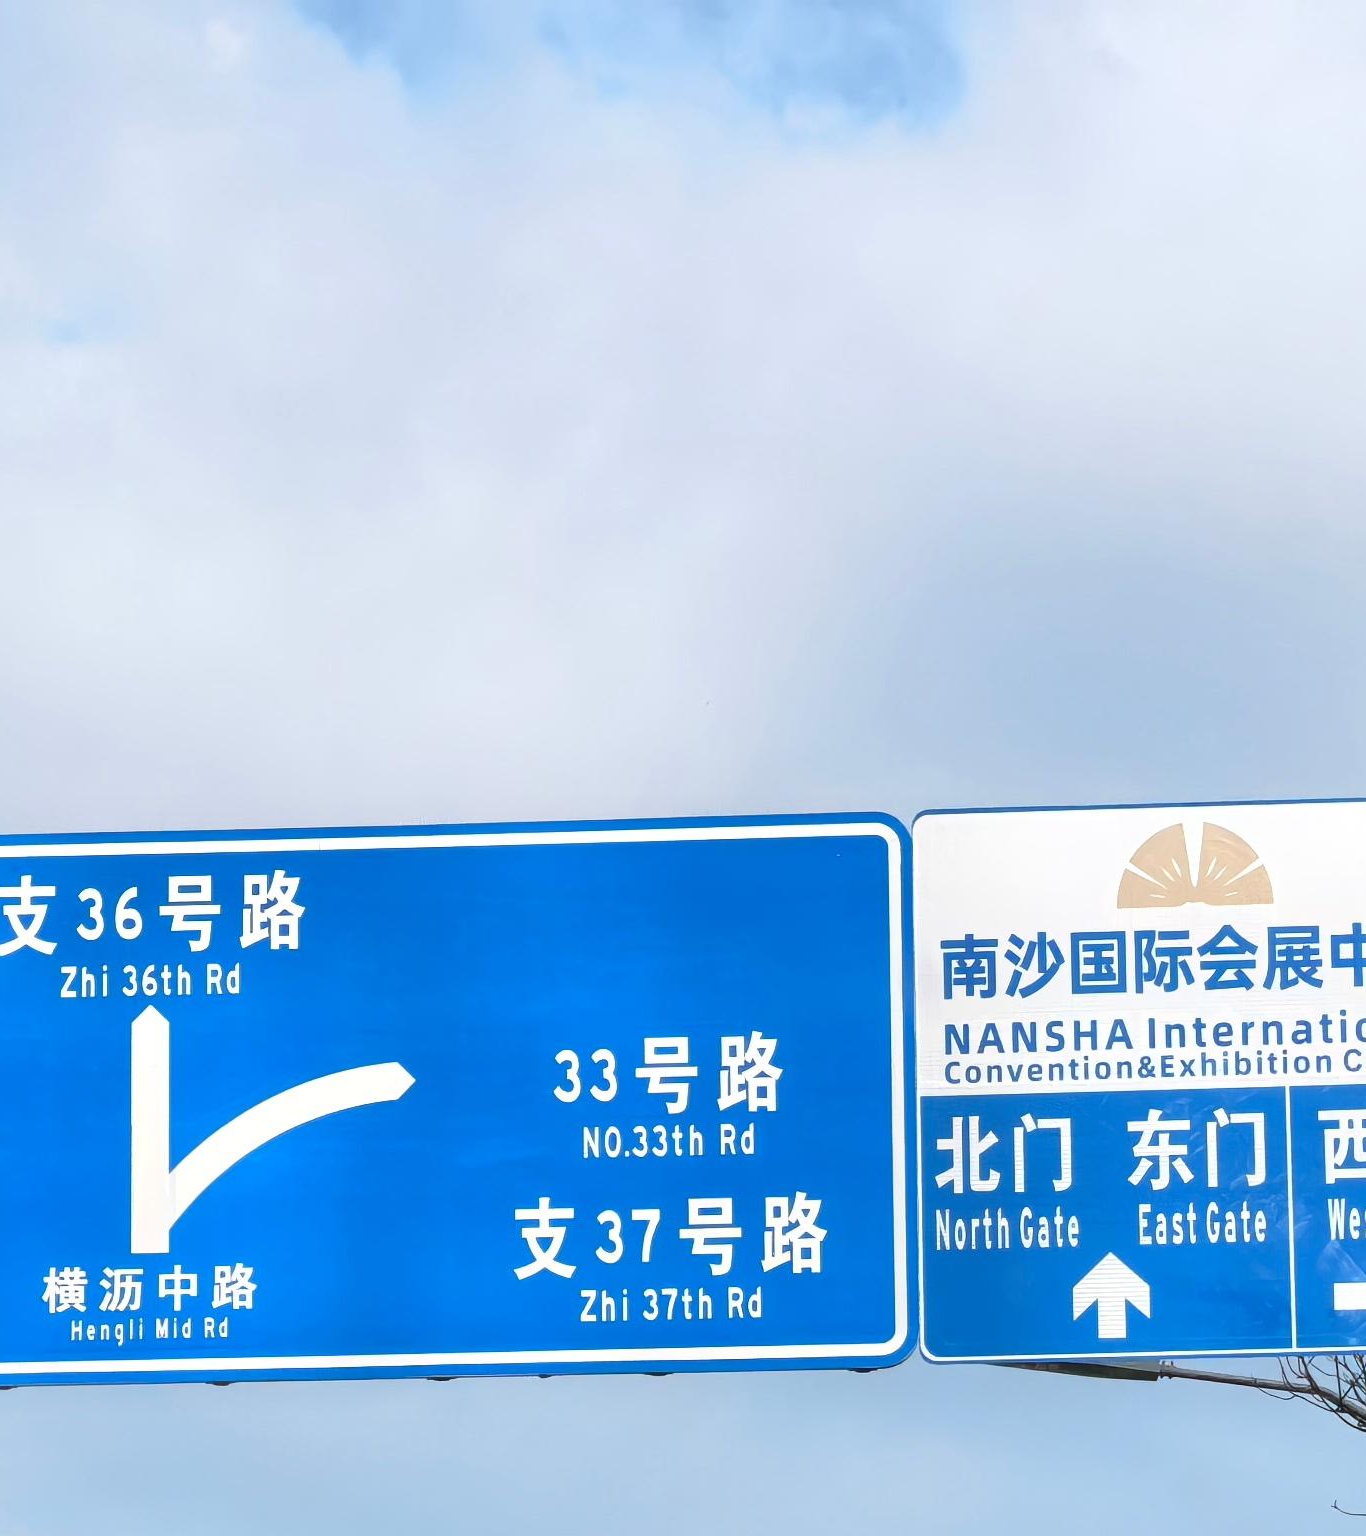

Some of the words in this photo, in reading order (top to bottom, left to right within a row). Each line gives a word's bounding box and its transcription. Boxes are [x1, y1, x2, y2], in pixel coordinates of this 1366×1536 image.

[60, 965, 108, 998] Zhi
[122, 964, 191, 997] 36th
[207, 962, 241, 995] Rd
[945, 1018, 1134, 1056] NANSHA
[553, 1030, 783, 1115] 33号路
[944, 1052, 1333, 1085] Convention&Exhibition
[583, 1124, 703, 1159] NO.33th
[720, 1122, 755, 1155] Rd
[935, 1113, 1073, 1194] 北门
[1127, 1107, 1267, 1191] 东门
[513, 1191, 828, 1281] 支37号路
[935, 1207, 1009, 1251] North
[1019, 1206, 1080, 1249] Gate
[1138, 1202, 1197, 1245] East
[1206, 1200, 1267, 1244] Gate
[41, 1262, 257, 1314] 横沥中路
[580, 1288, 628, 1322] Zhi
[642, 1287, 713, 1321] 37th
[727, 1286, 762, 1319] Rd
[71, 1318, 143, 1346] Hengli
[155, 1318, 192, 1339] Mid
[204, 1317, 229, 1338] Rd
